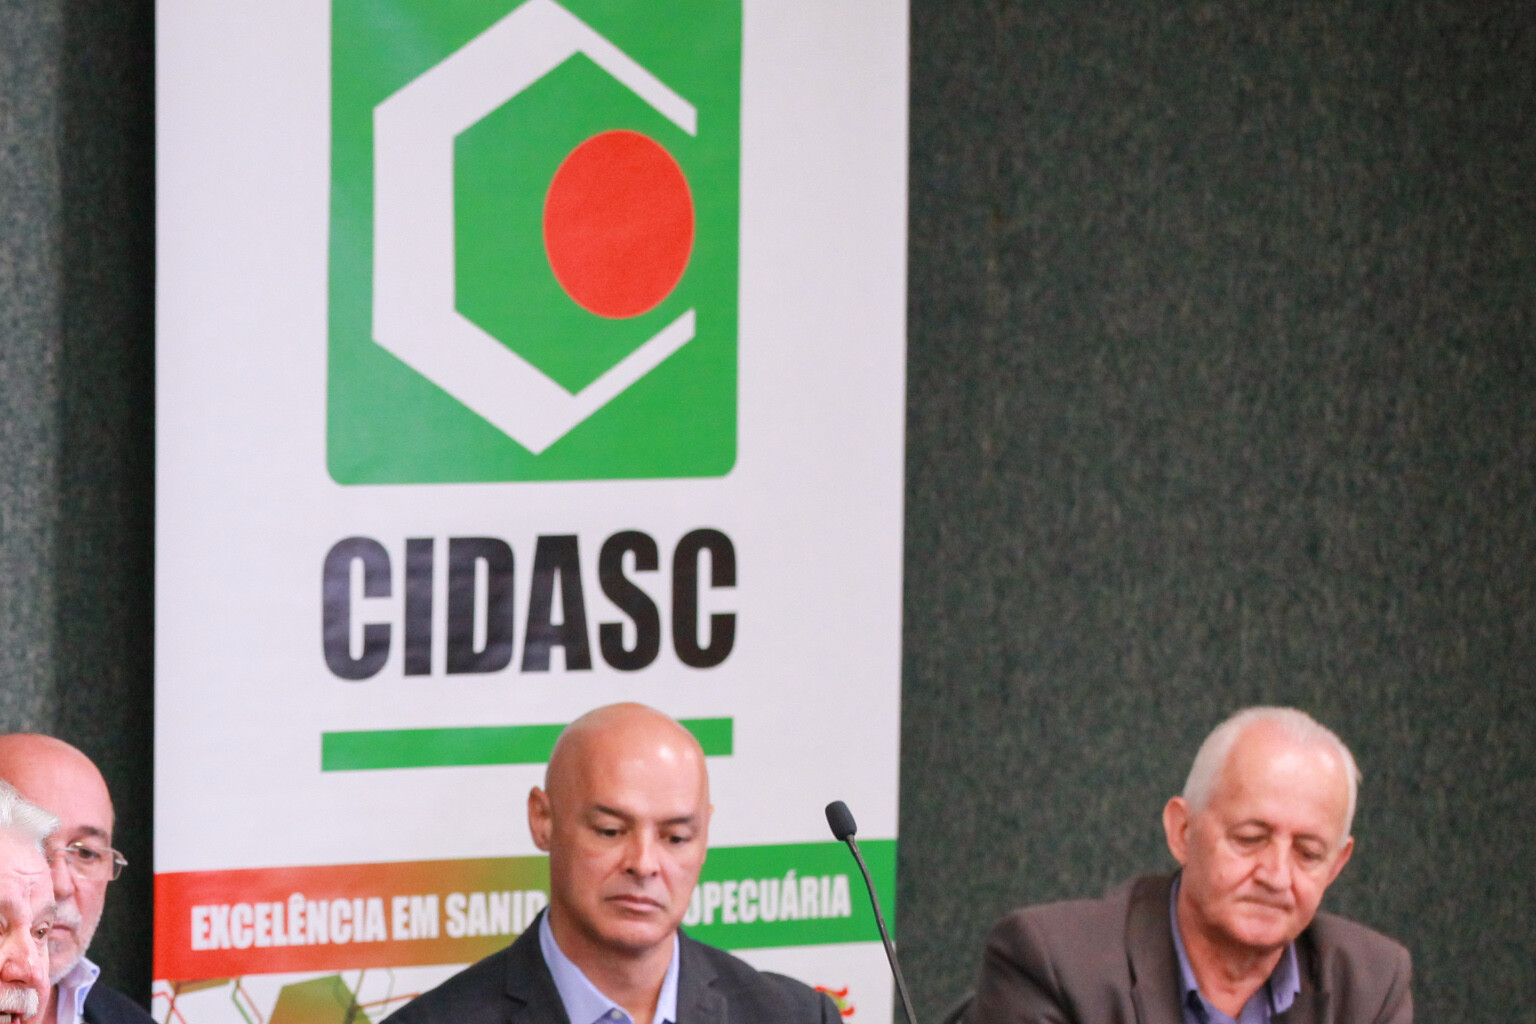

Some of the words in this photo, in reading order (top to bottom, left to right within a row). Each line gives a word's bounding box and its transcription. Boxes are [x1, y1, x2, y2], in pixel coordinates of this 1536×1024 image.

[322, 528, 737, 681] CIDASC
[191, 892, 388, 951] EXCELÊNCIA
[392, 894, 440, 940] EM
[445, 889, 548, 938] SANID
[681, 869, 852, 927] OPECUÁRIA
